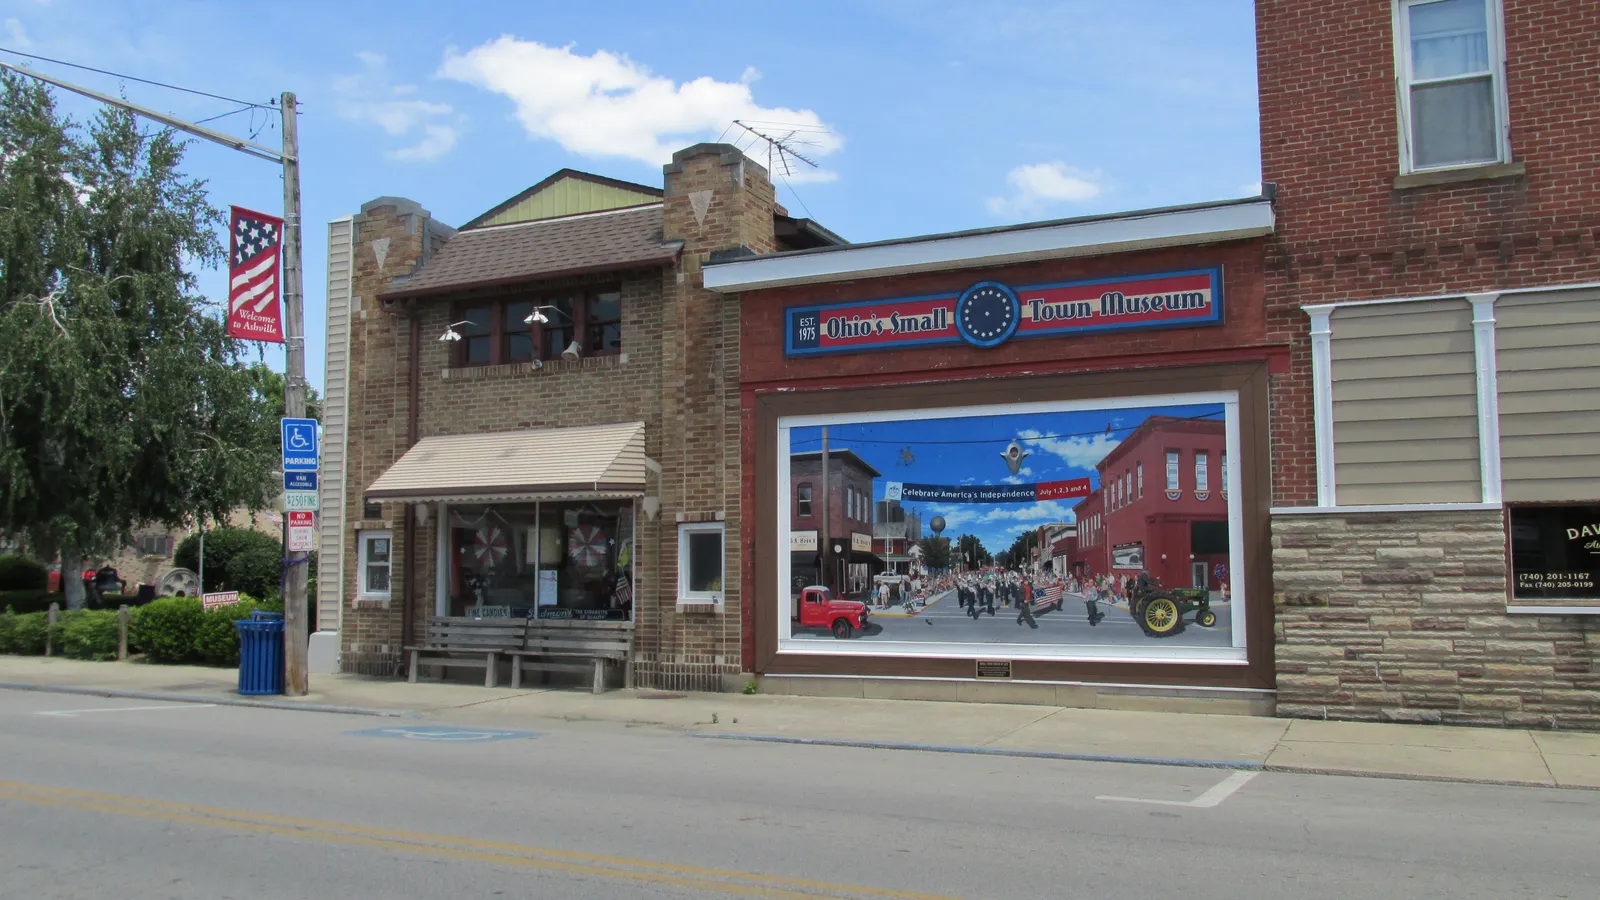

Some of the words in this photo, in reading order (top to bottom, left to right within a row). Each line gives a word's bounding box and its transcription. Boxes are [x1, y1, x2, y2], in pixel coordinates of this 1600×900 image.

[239, 309, 276, 323] Welcome
[827, 314, 884, 339] Ohio's
[891, 307, 948, 334] Small
[1029, 298, 1092, 322] Town
[1100, 290, 1206, 316] Museum
[800, 317, 815, 327] EST.
[233, 321, 241, 329] to
[243, 321, 277, 334] Ashville
[799, 327, 815, 341] 1975
[285, 457, 316, 465] PARKING
[902, 488, 939, 497] Celebrate
[941, 491, 978, 499] America's
[980, 490, 1035, 499] Independence
[1519, 573, 1543, 581] (740)
[1546, 572, 1590, 580] 201-1167
[206, 593, 238, 602] MUSEUM
[482, 608, 508, 617] CANDIES
